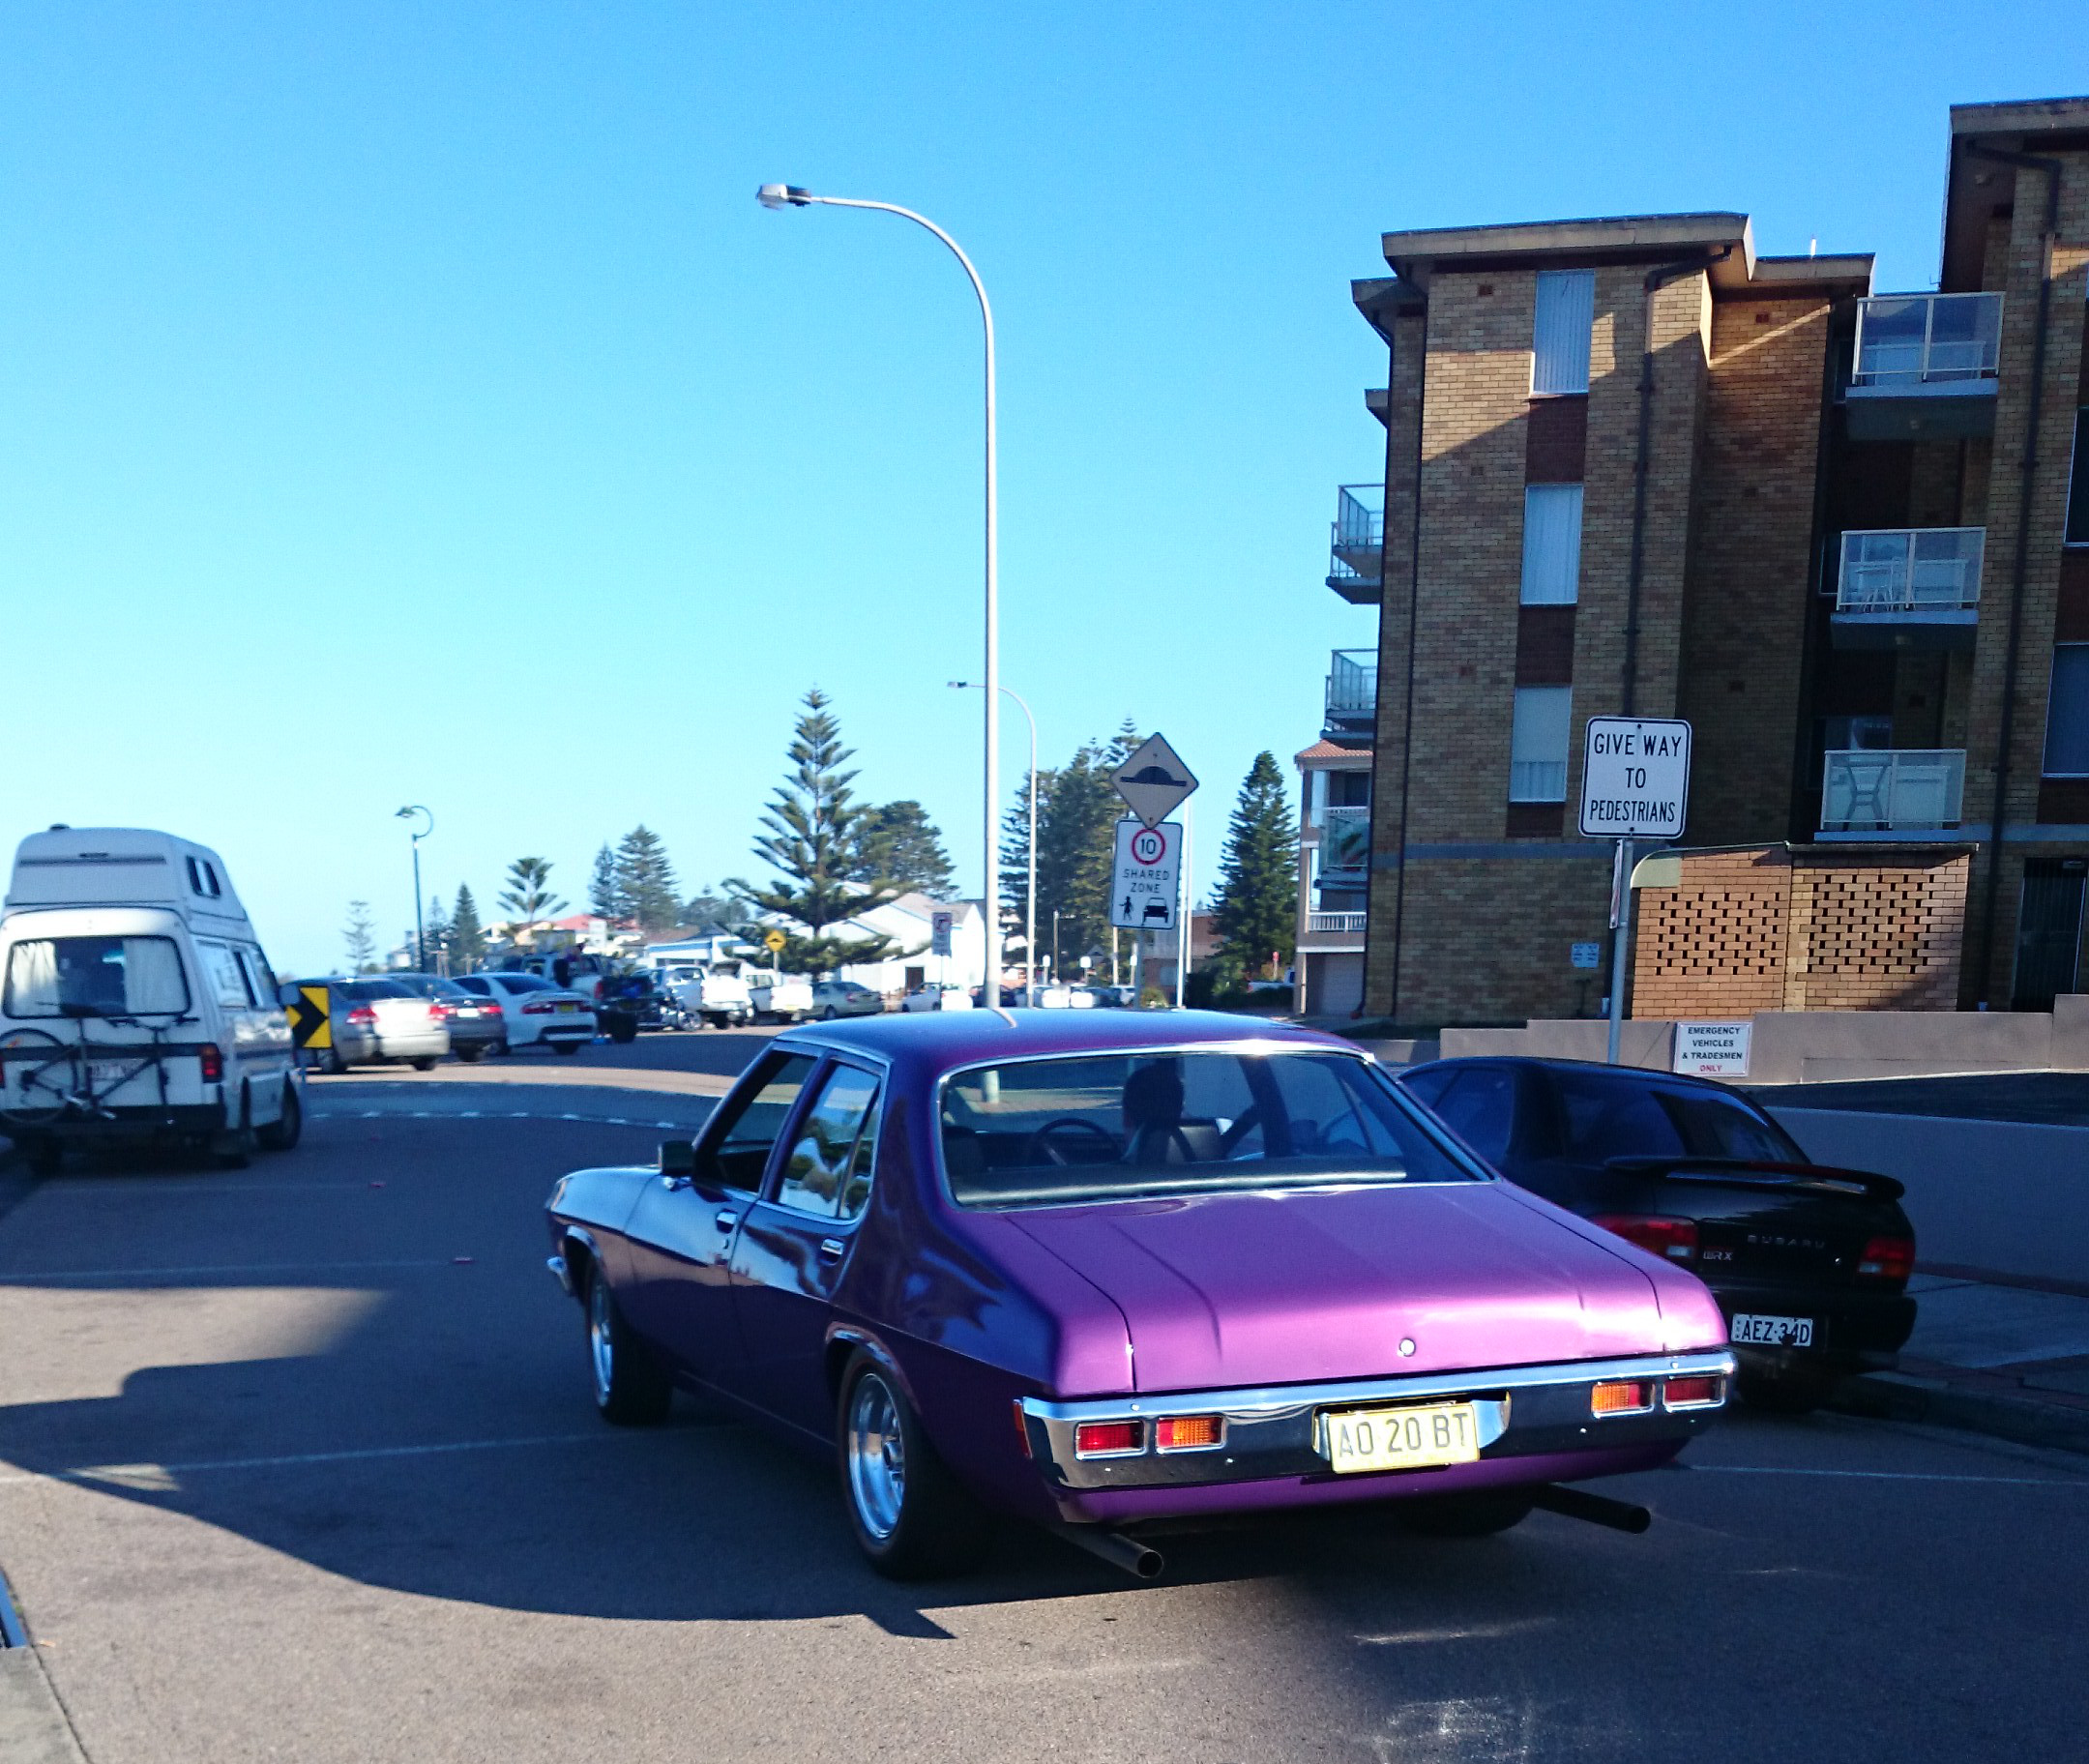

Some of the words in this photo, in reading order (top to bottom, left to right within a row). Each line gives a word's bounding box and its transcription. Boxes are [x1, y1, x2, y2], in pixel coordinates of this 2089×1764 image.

[1594, 733, 1635, 754] GIVE
[1643, 735, 1682, 756] WAY
[1625, 767, 1647, 789] TO
[1589, 800, 1676, 823] PEDESTRIANS
[1140, 838, 1157, 855] 10
[1122, 868, 1170, 881] SHARED
[1130, 882, 1162, 894] ZONE
[1688, 1026, 1741, 1035] EMERGENCY
[1747, 1234, 1825, 1249] SUBARU
[1703, 1250, 1733, 1261] WRX
[1385, 1416, 1422, 1454] 20
[1431, 1412, 1468, 1449] BT
